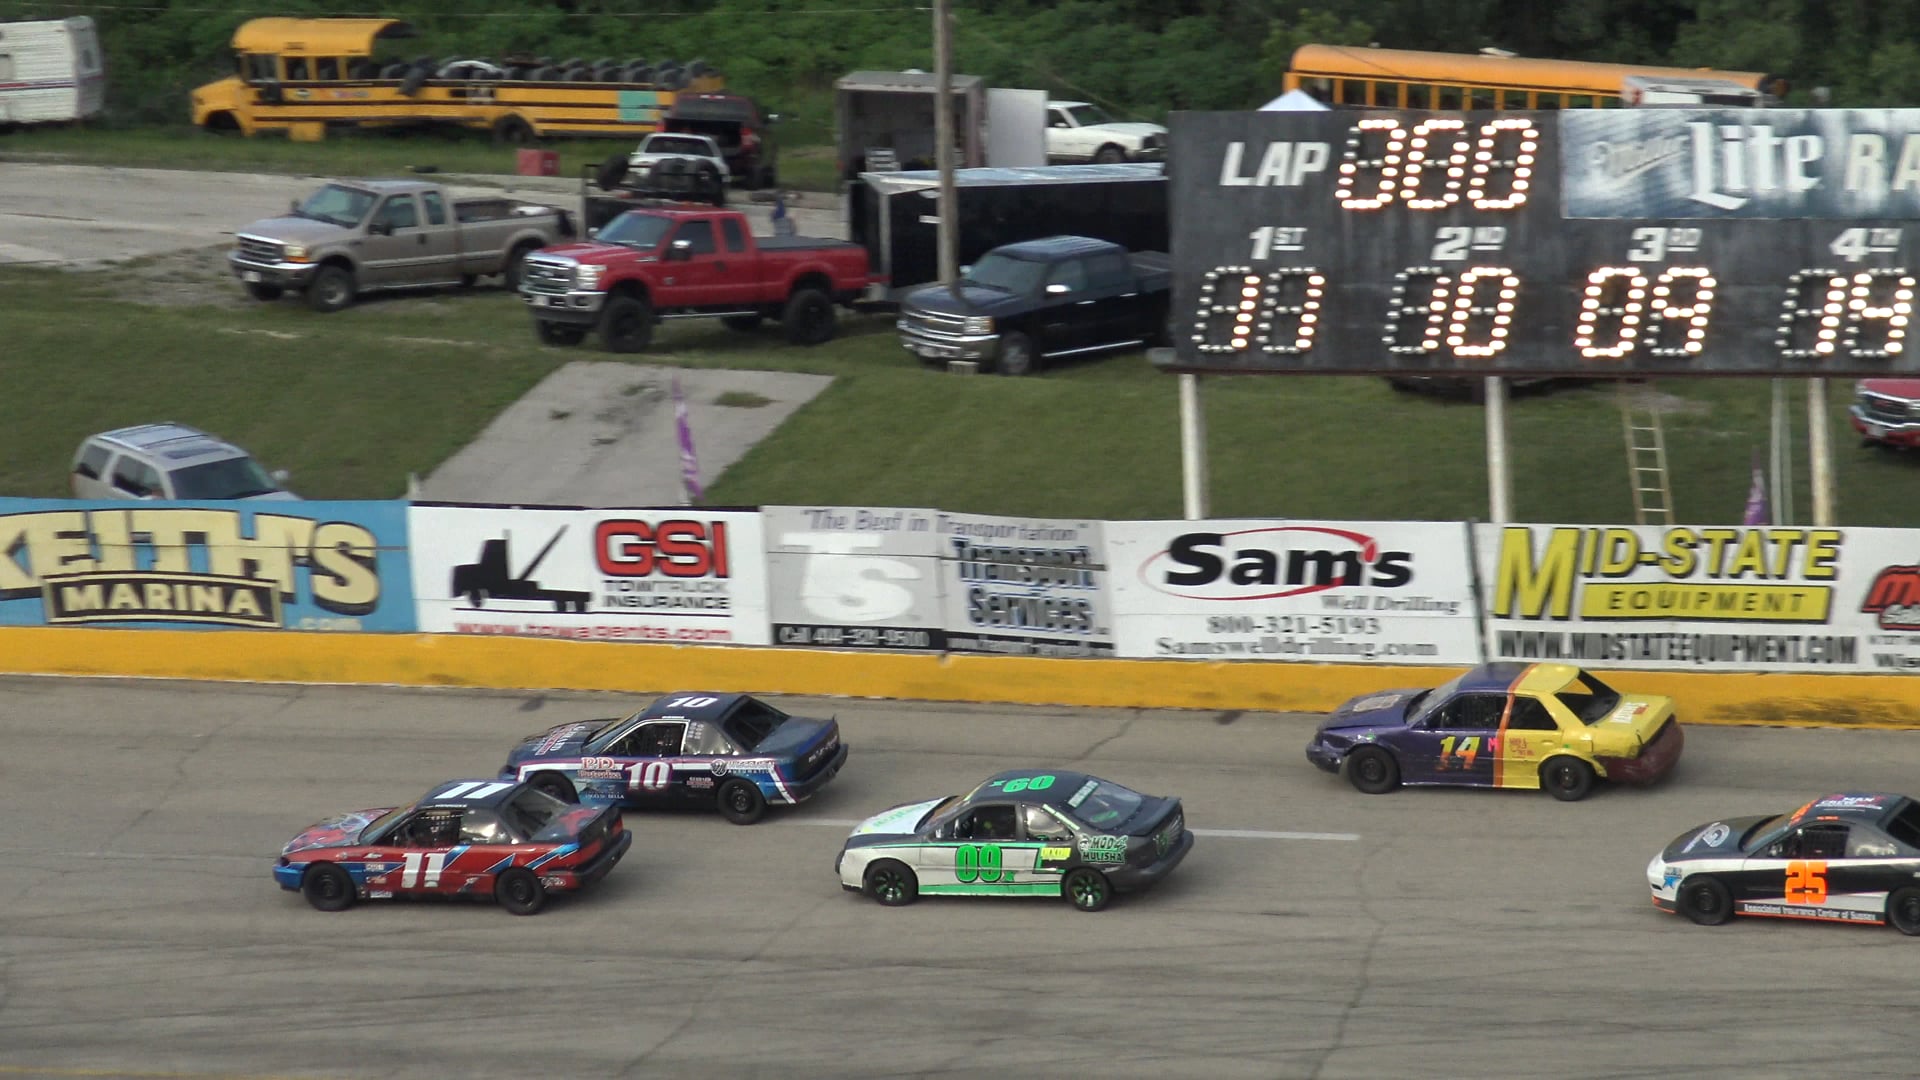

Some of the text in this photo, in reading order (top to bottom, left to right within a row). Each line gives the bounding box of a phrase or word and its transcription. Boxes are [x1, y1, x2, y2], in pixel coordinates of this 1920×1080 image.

[1219, 141, 1331, 186] LAP
[1686, 121, 1824, 210] Lite
[1249, 226, 1308, 261] 1ST
[1430, 226, 1508, 261] 2ND
[1626, 227, 1703, 262] 3RD
[1828, 227, 1904, 262] 4TH
[1574, 266, 1718, 358] 09
[855, 509, 904, 532] Best
[594, 518, 731, 579] GSI
[60, 582, 266, 617] MARINA
[601, 595, 731, 610] INSURANCE
[1320, 595, 1461, 616] Well Drilling
[1607, 590, 1807, 613] EQUIPMENT
[1206, 615, 1383, 635] 800-321-5193
[666, 696, 719, 709] 10
[1436, 736, 1482, 771] 14
[433, 782, 519, 800] 11
[624, 761, 674, 792] 10
[401, 852, 448, 889] 11
[954, 844, 1003, 884] 09
[1784, 860, 1830, 905] 25
